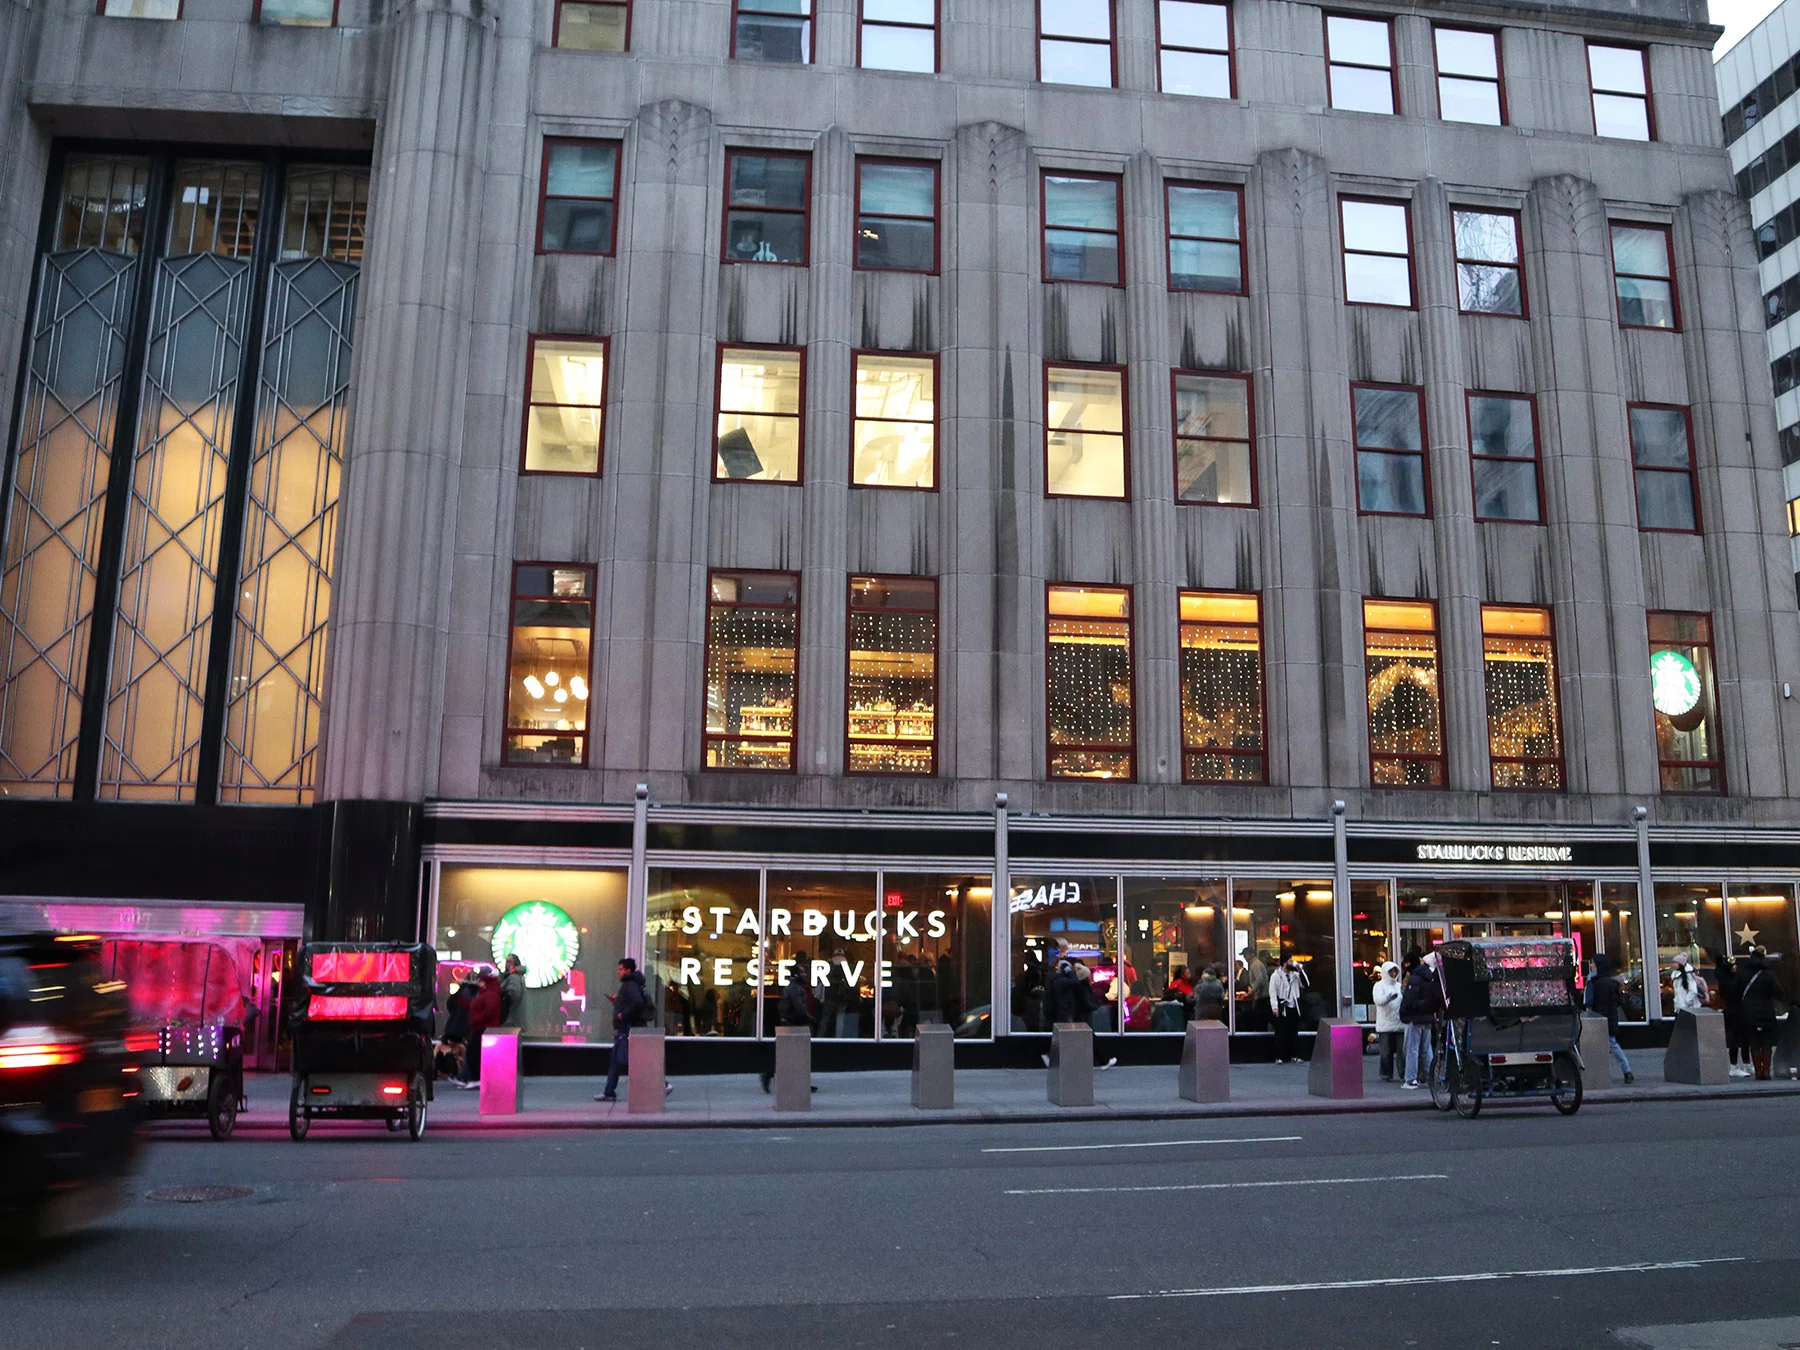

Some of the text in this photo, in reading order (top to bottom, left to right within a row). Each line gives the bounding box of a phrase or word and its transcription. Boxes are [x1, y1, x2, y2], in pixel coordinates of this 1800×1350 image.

[1417, 844, 1573, 862] STARBUCKS RESERVE
[682, 906, 946, 938] STARBUCKS
[680, 957, 893, 988] RESERVE
